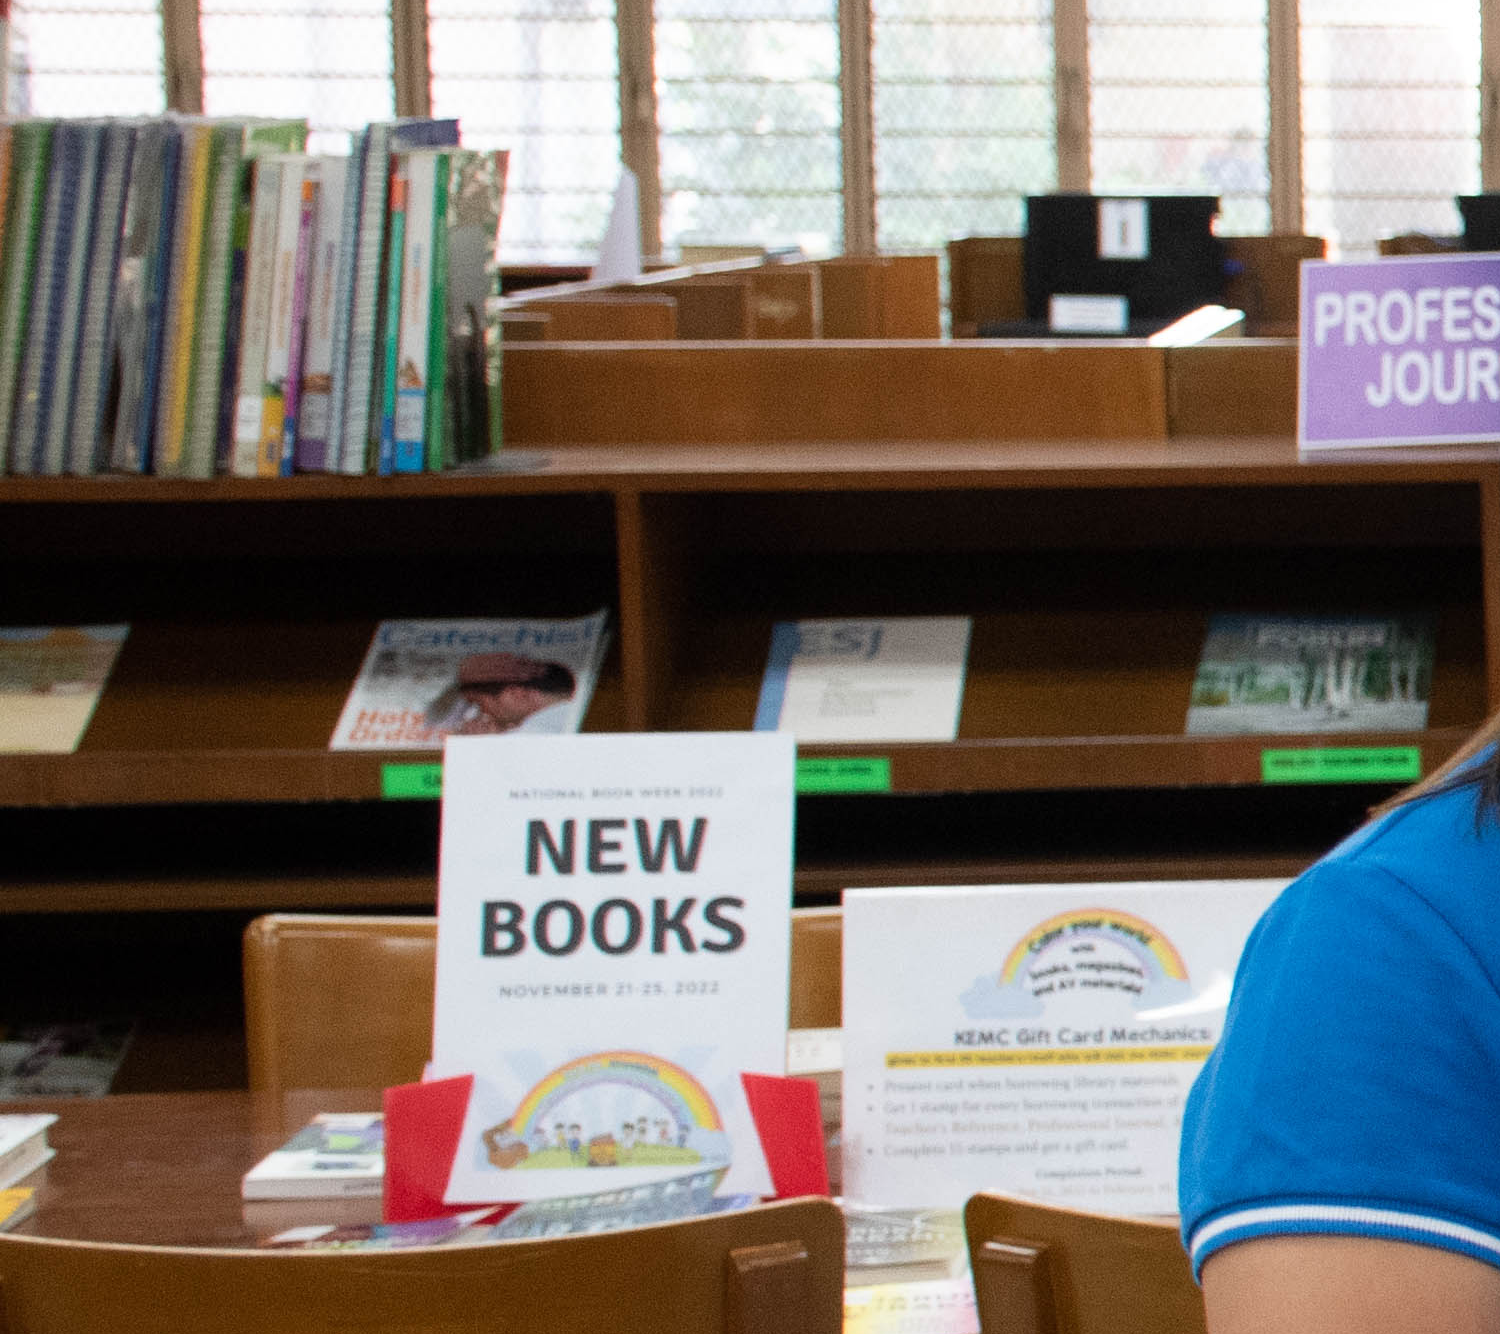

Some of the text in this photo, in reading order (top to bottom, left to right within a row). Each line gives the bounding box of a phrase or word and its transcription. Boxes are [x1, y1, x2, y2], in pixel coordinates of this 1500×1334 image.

[509, 788, 585, 800] NATIONAL
[591, 787, 634, 799] BOOK
[640, 787, 682, 798] WEEK
[525, 817, 709, 875] NEW
[481, 896, 746, 957] BOOKS
[499, 982, 608, 999] NOVEMBER
[674, 979, 720, 996] 2022
[954, 1030, 1010, 1047] KEMC
[1015, 1029, 1051, 1045] Gift
[1057, 1027, 1105, 1045] Card
